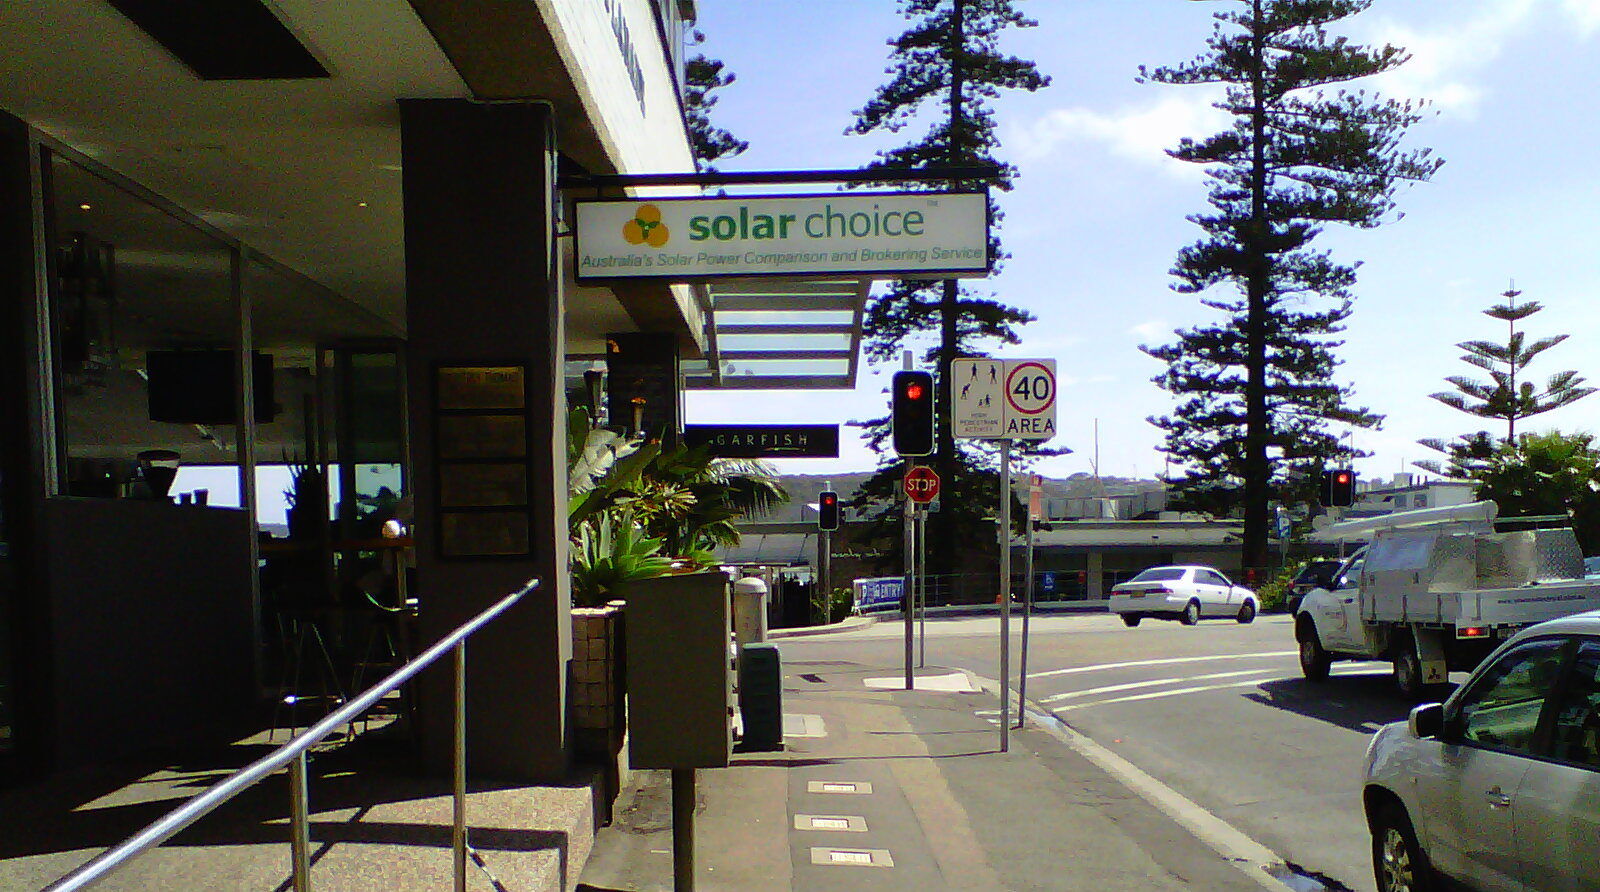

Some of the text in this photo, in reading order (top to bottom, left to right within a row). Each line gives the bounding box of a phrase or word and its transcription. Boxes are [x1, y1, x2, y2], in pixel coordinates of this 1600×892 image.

[689, 204, 925, 241] solar choice
[582, 246, 982, 268] Australia's Solar Power Comparison and Brokering Service
[1013, 376, 1049, 400] 40
[1007, 418, 1055, 433] AREA
[717, 434, 807, 446] GARFISH
[908, 478, 936, 491] STOP
